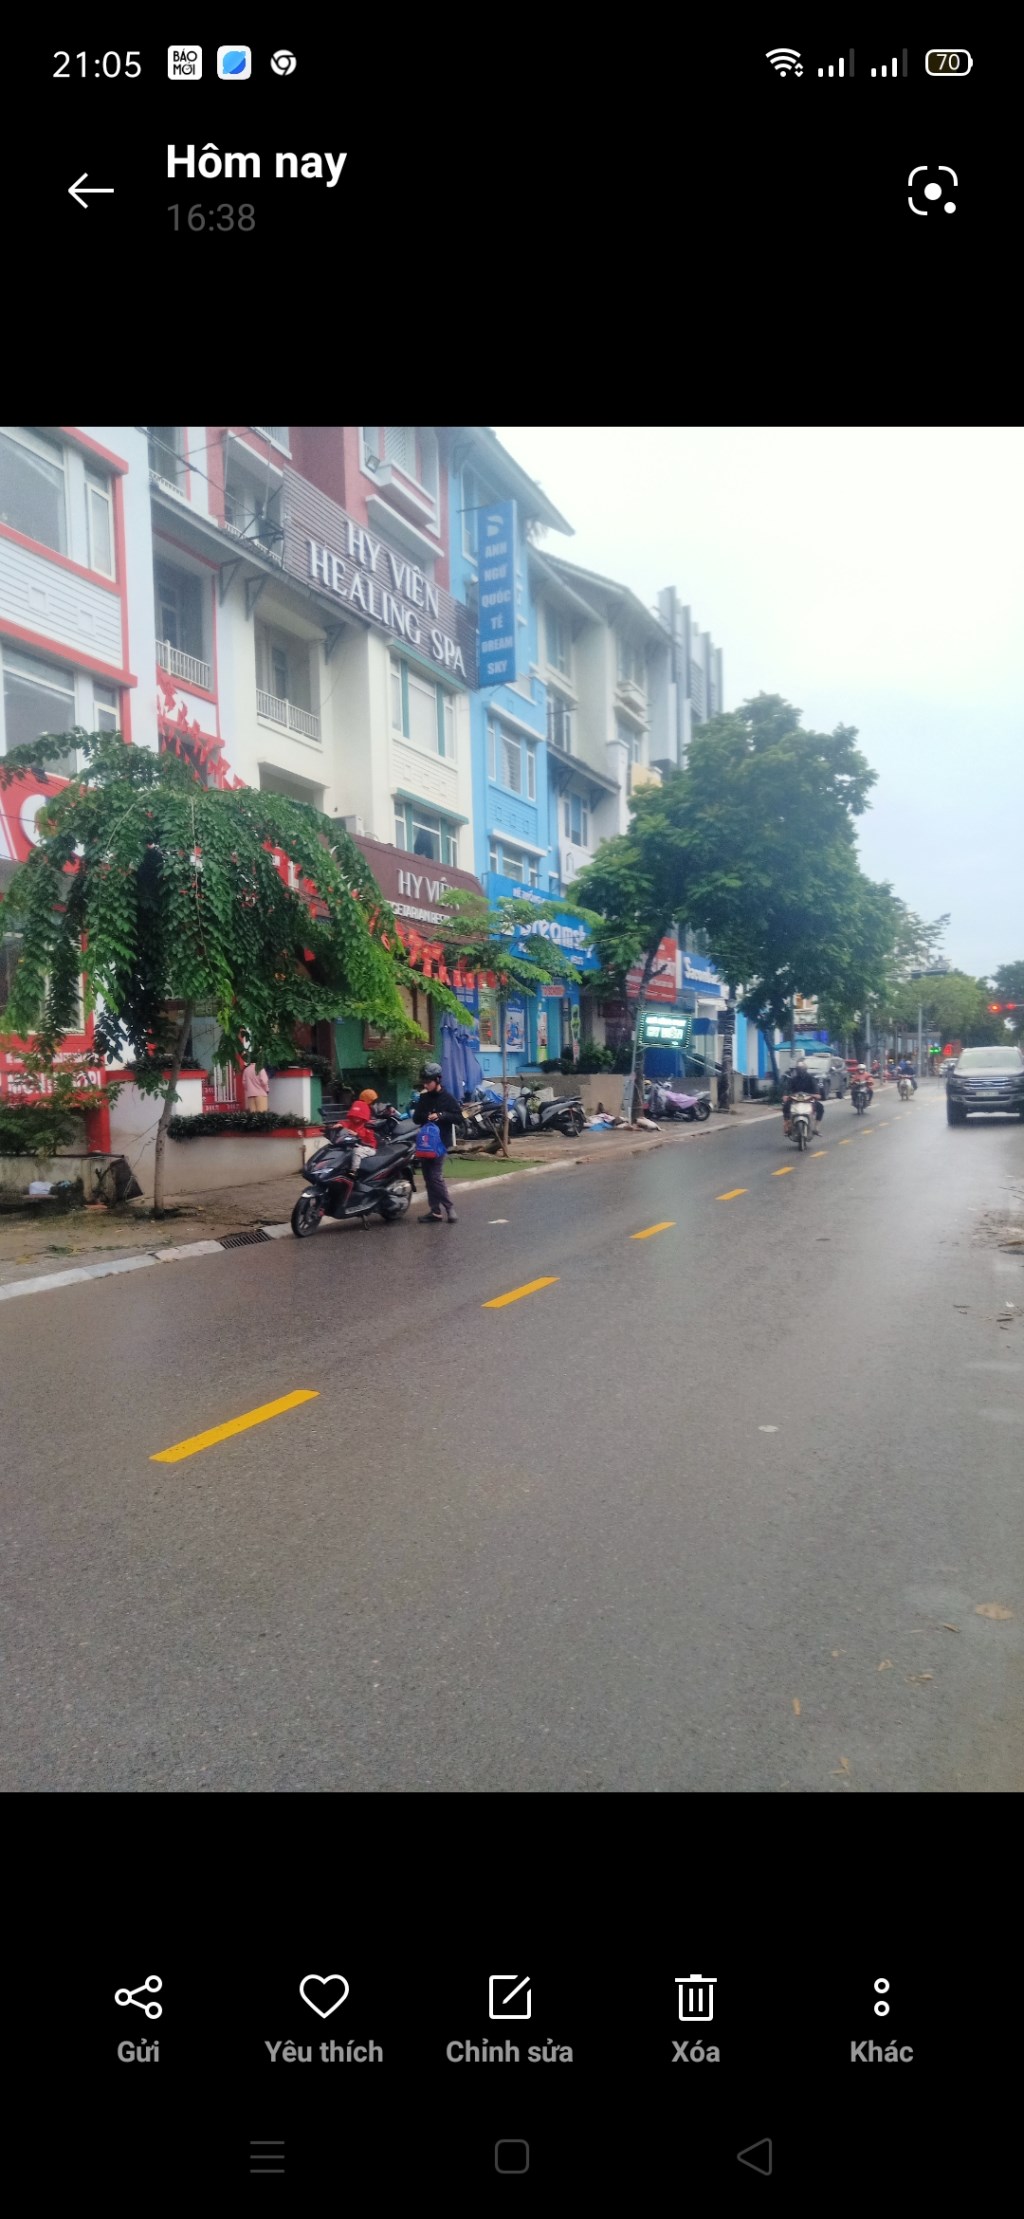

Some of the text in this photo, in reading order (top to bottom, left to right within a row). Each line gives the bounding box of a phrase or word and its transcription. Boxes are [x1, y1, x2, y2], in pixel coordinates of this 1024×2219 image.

[307, 539, 468, 678] HEALING SPA
[346, 519, 439, 620] HY VIÊN
[397, 868, 423, 900] HY
